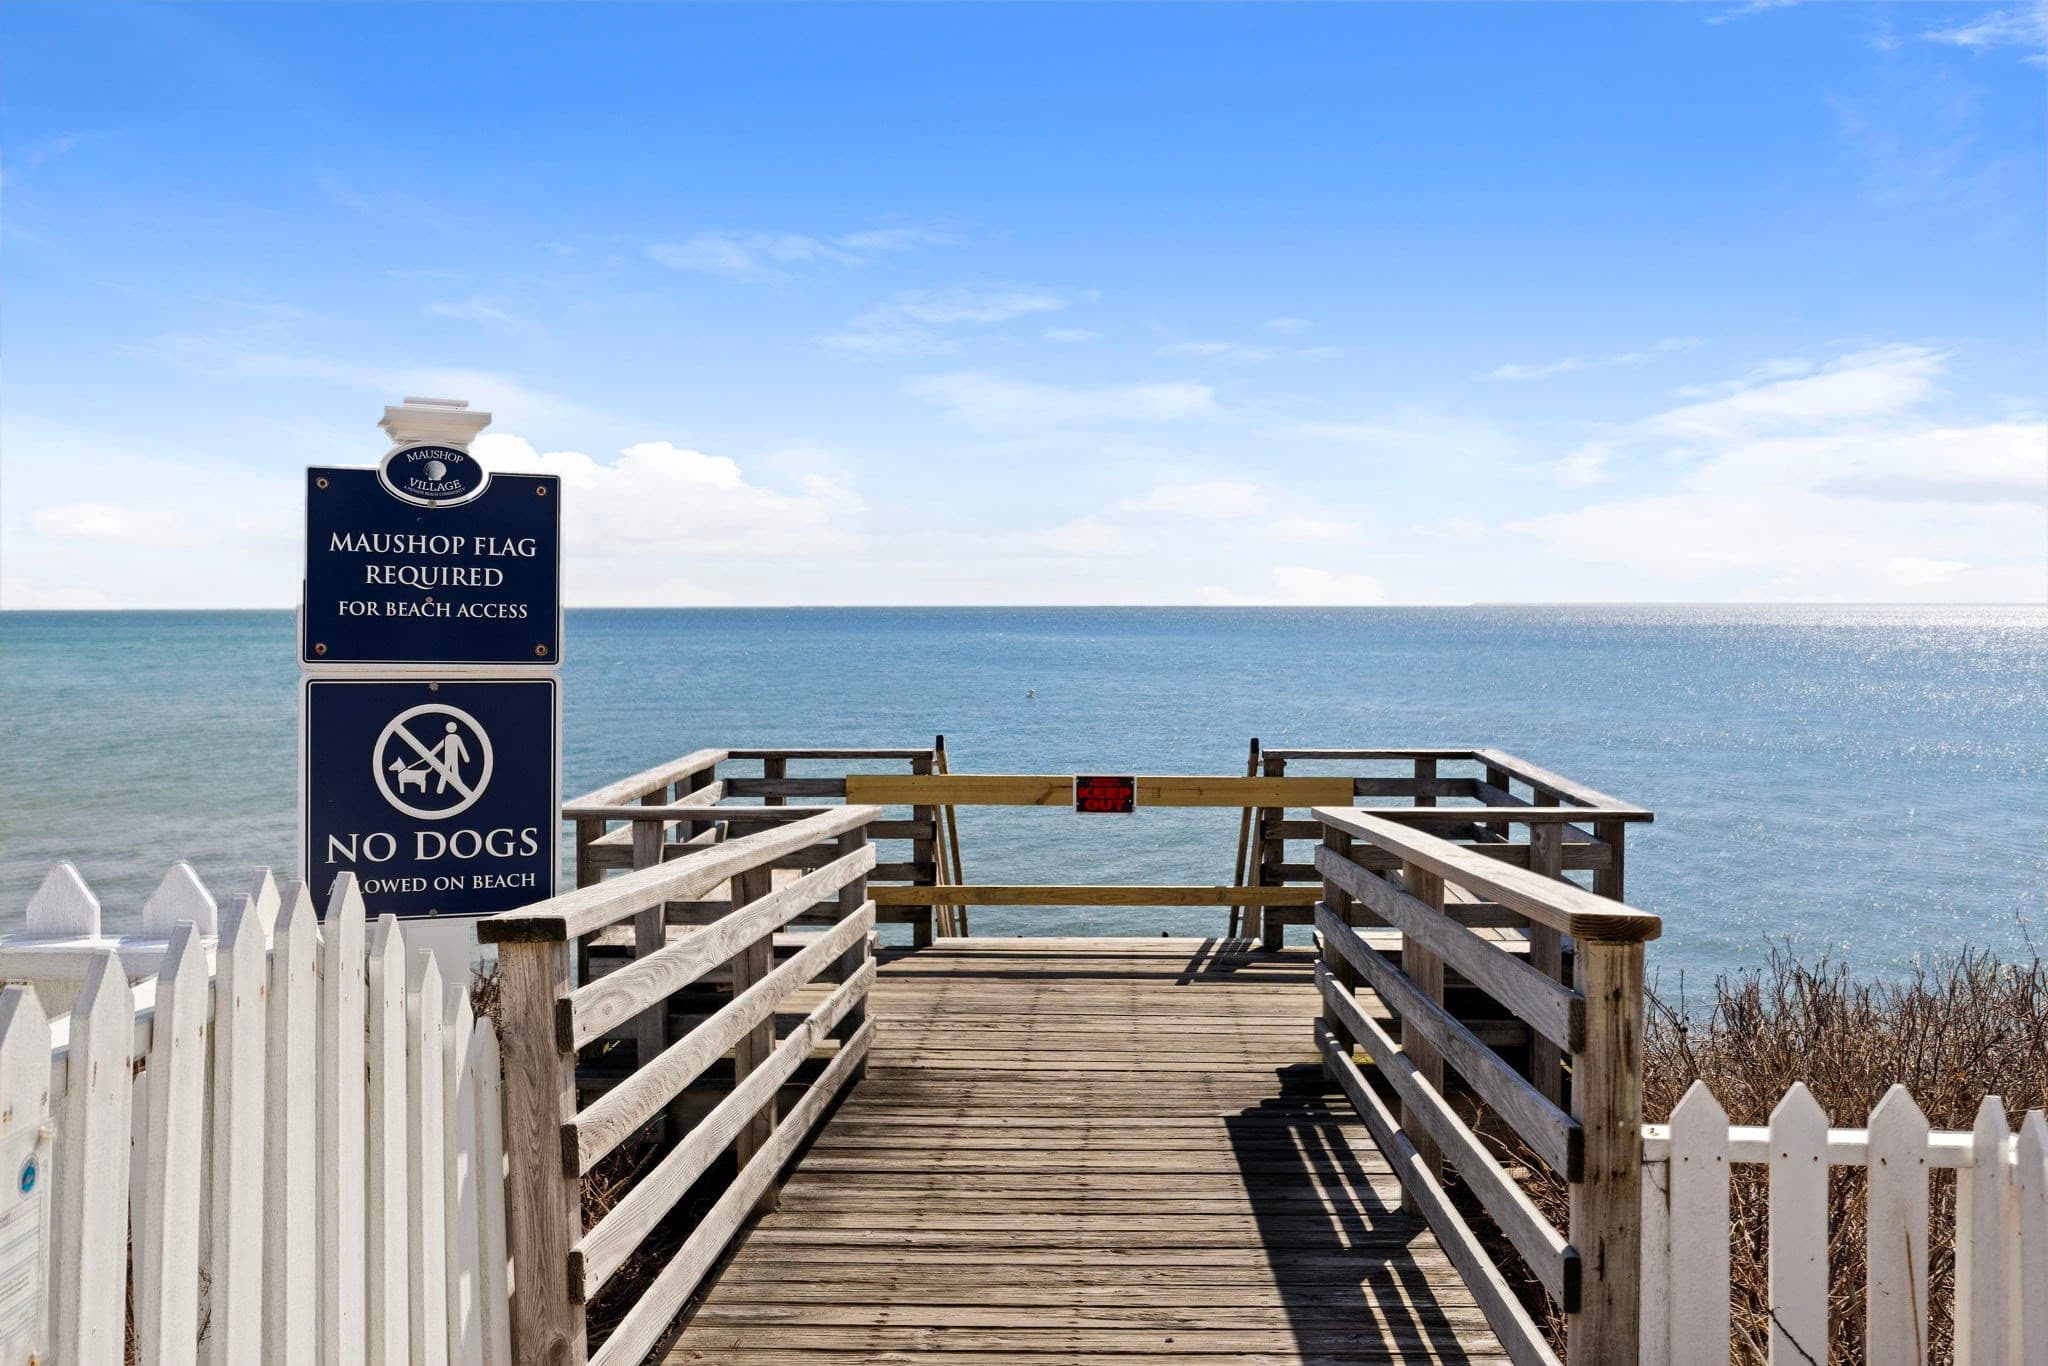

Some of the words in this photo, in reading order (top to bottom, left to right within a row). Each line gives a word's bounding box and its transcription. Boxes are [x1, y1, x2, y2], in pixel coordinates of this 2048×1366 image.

[406, 450, 464, 463] MAUSHOP
[410, 477, 462, 492] VILLAGE
[330, 532, 465, 555] MAUSHOP
[474, 536, 537, 557] FLAG
[365, 565, 504, 590] REQUIRED
[338, 600, 380, 617] FOR
[386, 602, 451, 618] BEACH
[457, 603, 528, 619] ACCESS
[1078, 787, 1130, 798] KEEP
[1085, 799, 1125, 810] OUT
[324, 832, 397, 864] NO
[414, 827, 538, 861] DOGS
[326, 877, 427, 896] OWED
[433, 876, 465, 891] ON
[473, 872, 535, 889] BEACH
